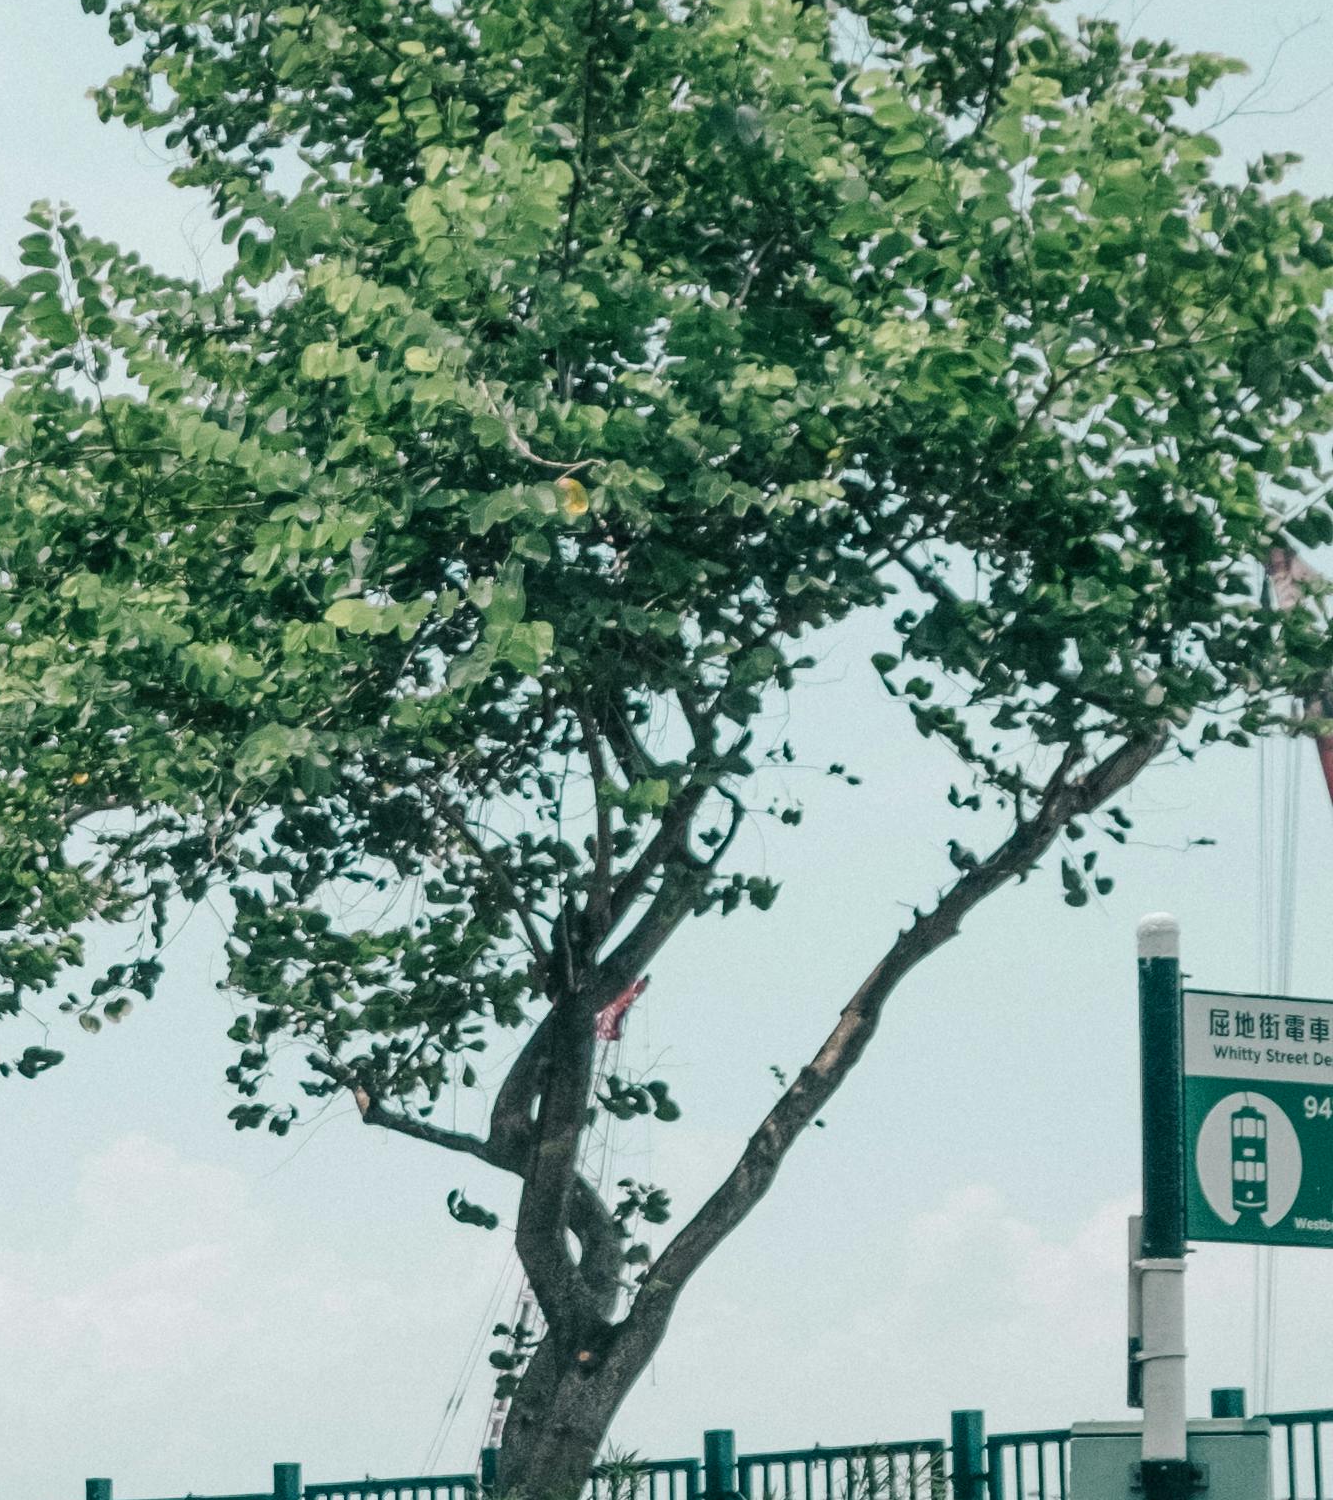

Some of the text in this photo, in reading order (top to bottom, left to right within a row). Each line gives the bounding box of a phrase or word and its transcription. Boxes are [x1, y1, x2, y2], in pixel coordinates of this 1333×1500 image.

[1209, 1008, 1331, 1044] 屈地街電車
[1213, 1044, 1333, 1066] Whitty Street De
[1303, 1095, 1333, 1119] 94
[1294, 1217, 1333, 1231] Westb
